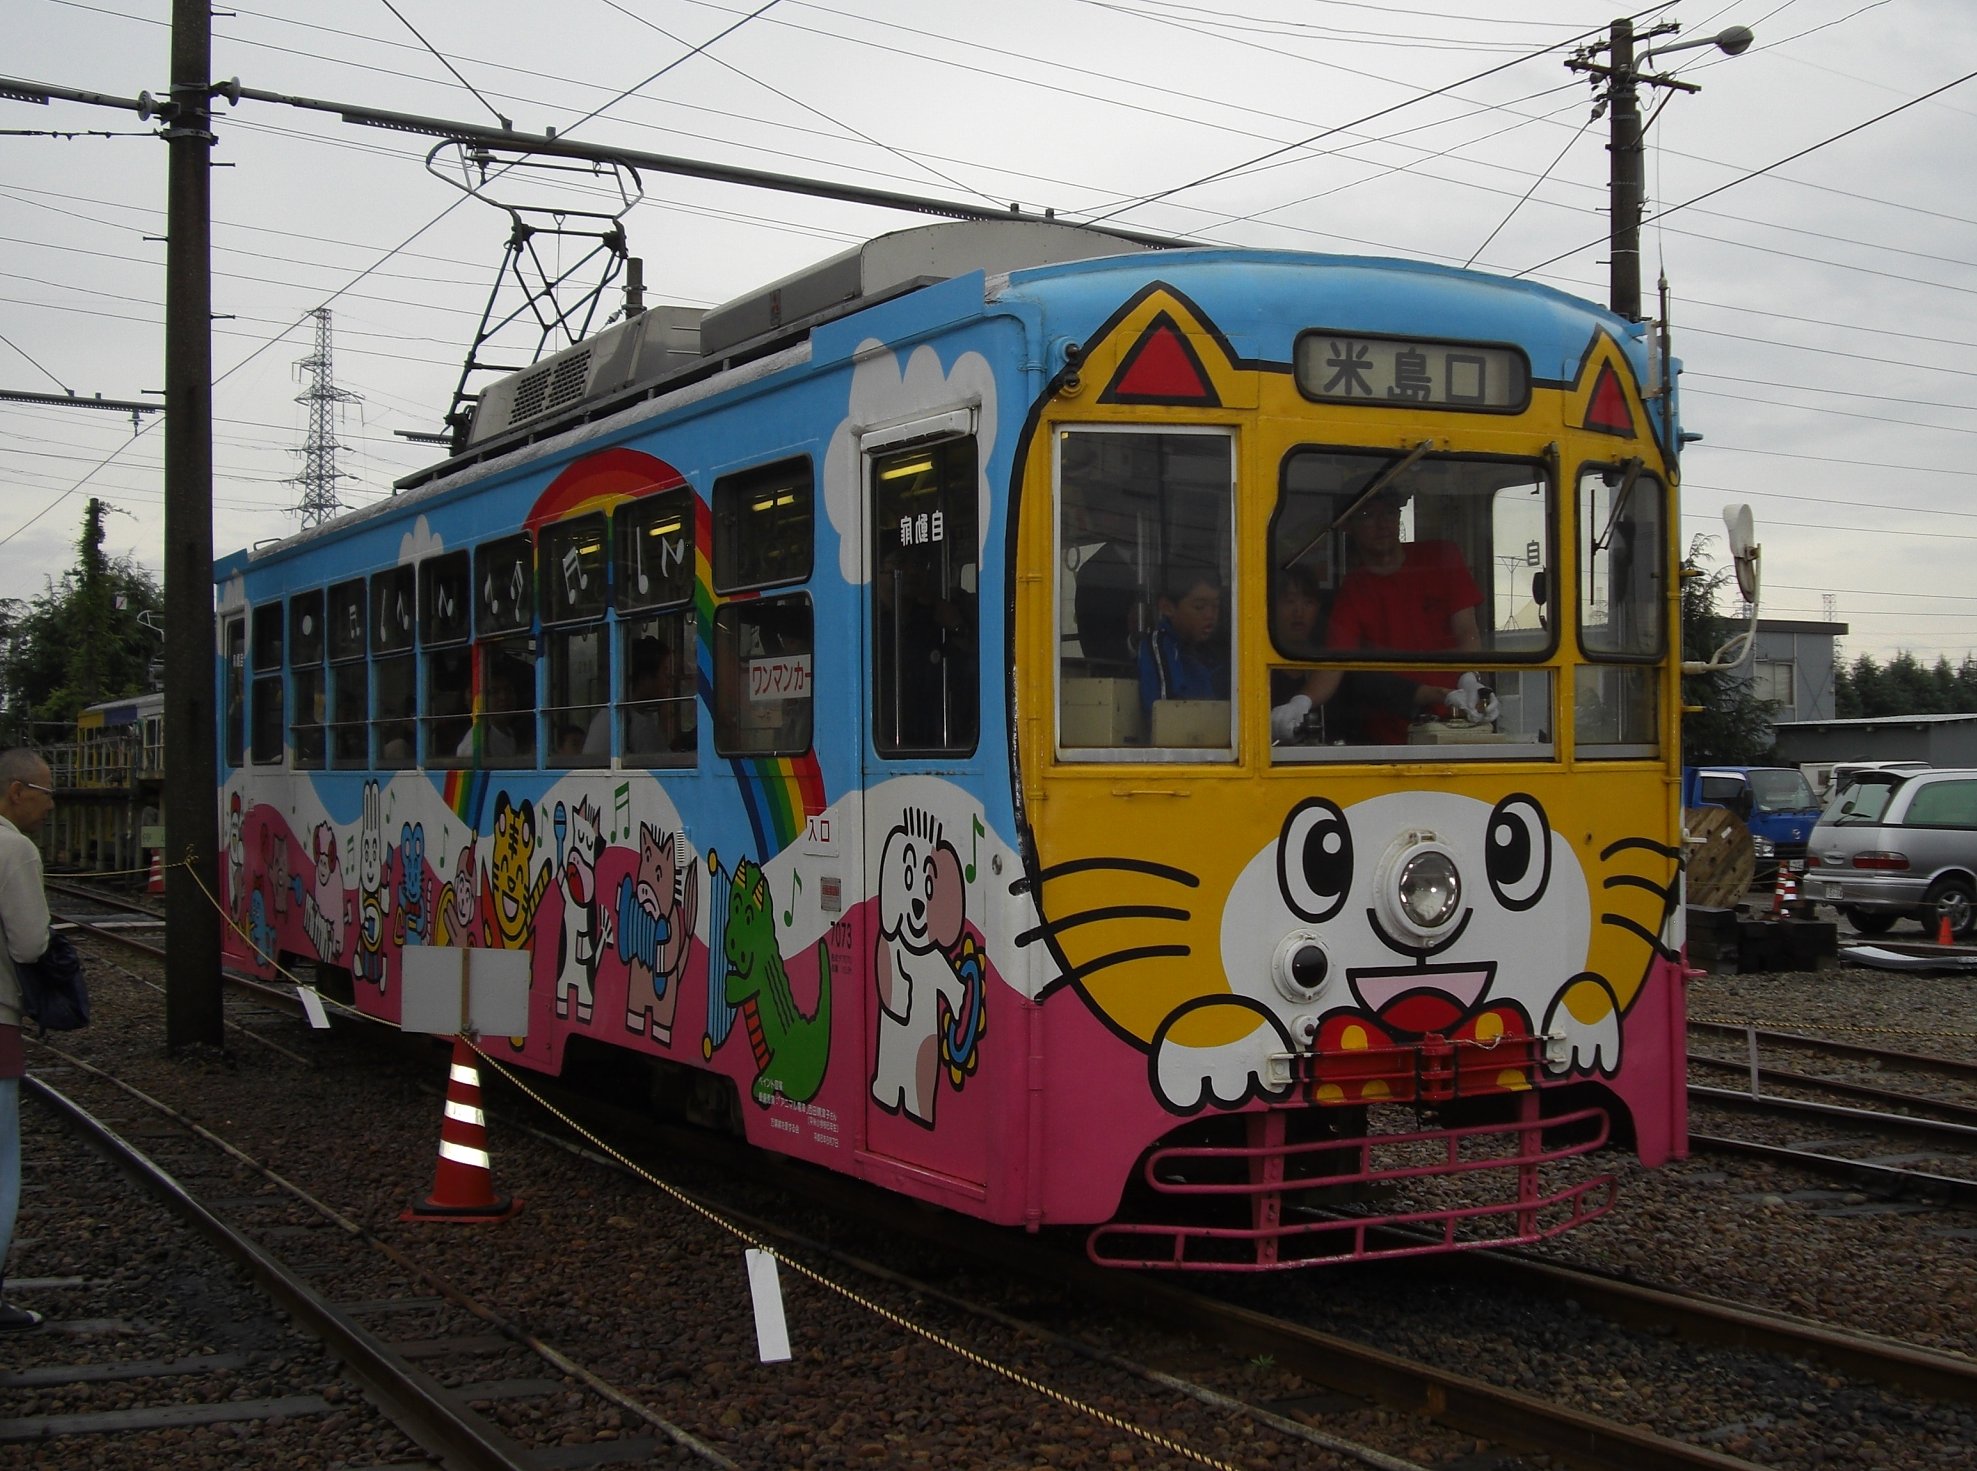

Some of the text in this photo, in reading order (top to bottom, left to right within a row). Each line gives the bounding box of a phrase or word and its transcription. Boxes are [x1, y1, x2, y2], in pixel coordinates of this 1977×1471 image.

[1322, 341, 1486, 405] 米島口
[752, 660, 812, 696] ワンマンカー
[808, 819, 830, 842] 入口
[830, 921, 852, 950] 7073
